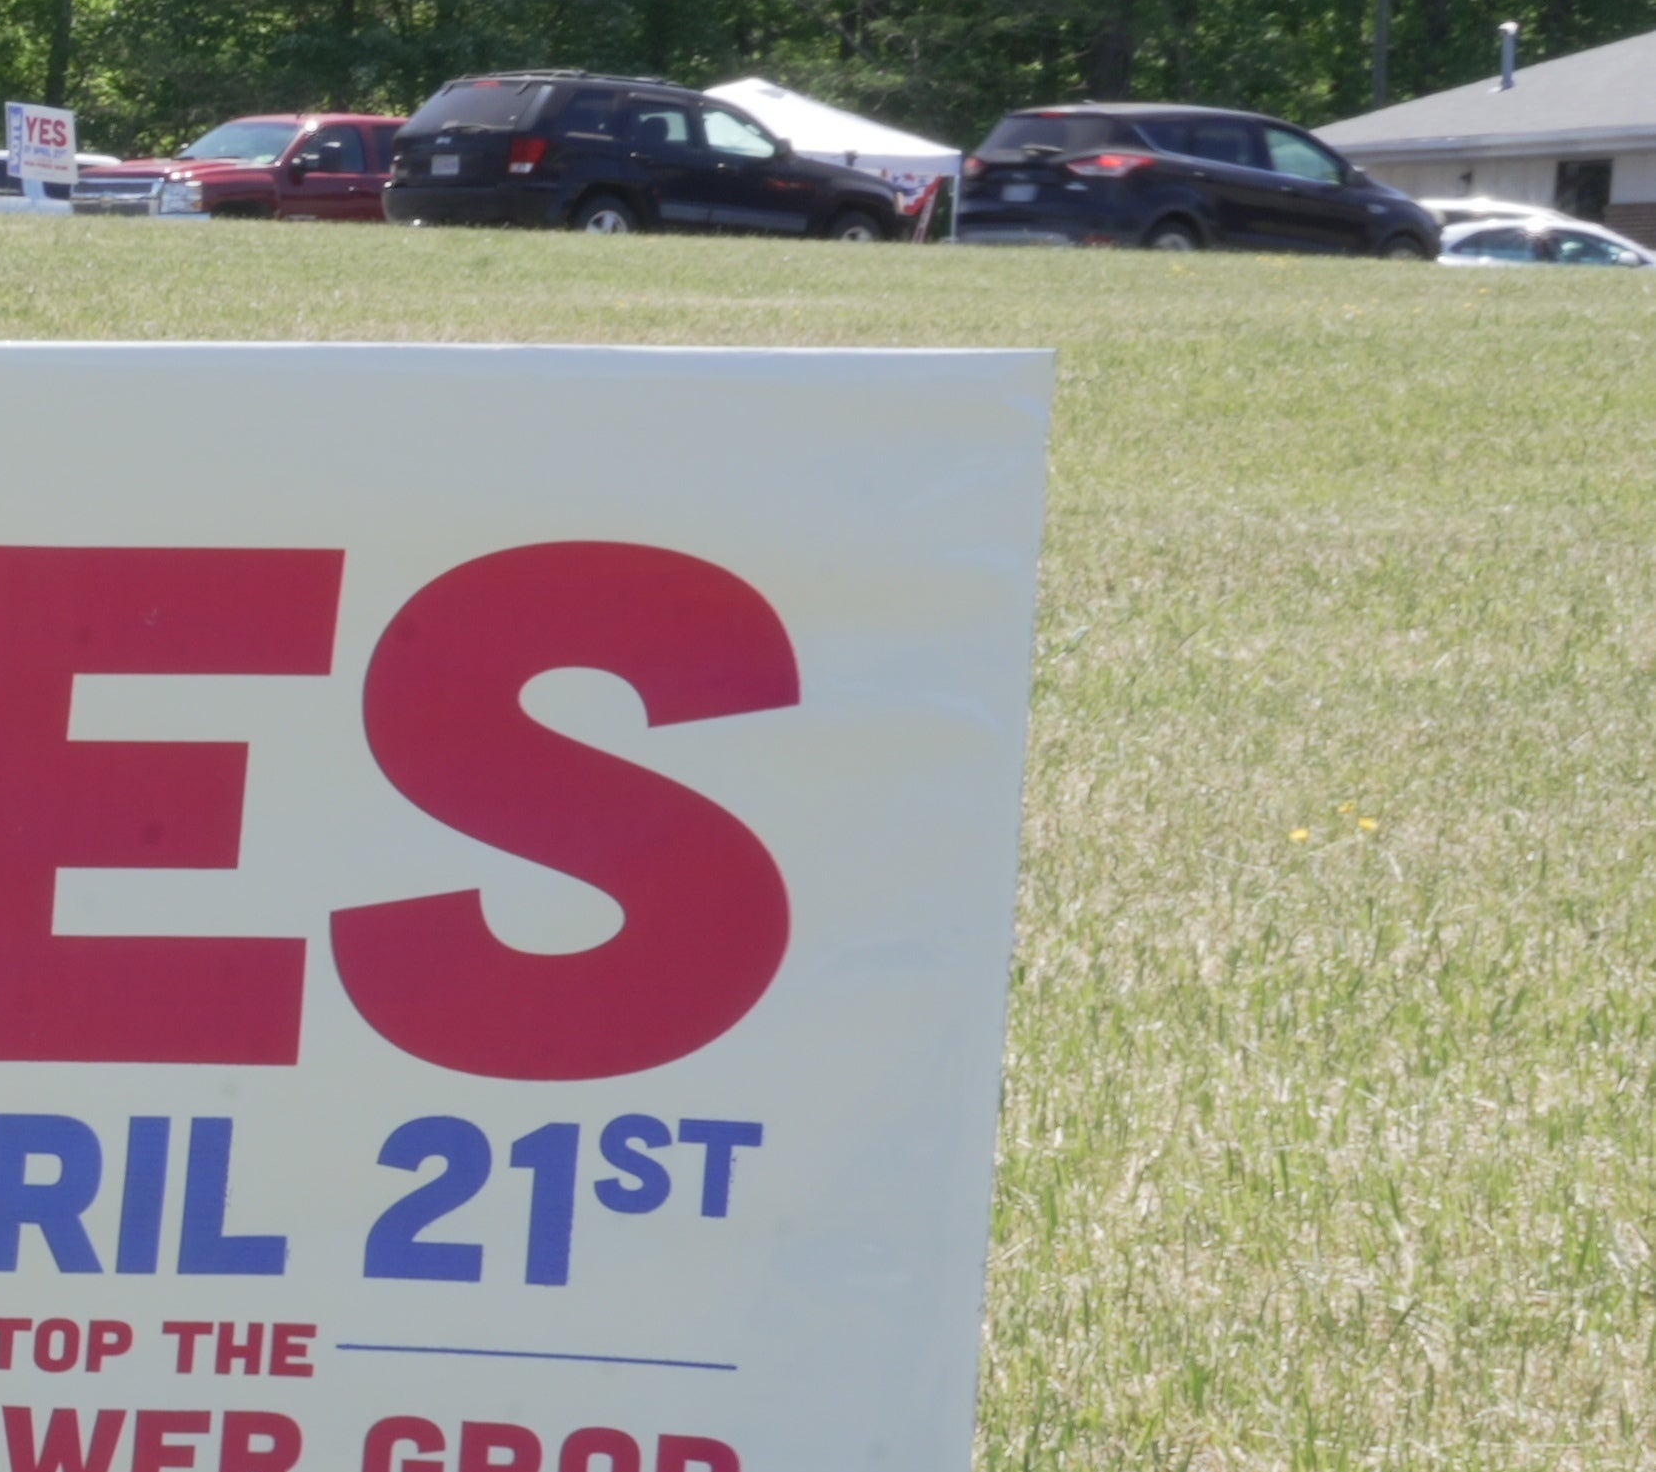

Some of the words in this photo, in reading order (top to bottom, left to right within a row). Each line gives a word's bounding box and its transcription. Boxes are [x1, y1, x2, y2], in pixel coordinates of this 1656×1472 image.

[26, 116, 67, 147] YES
[361, 1114, 764, 1287] 21ST
[162, 1319, 317, 1379] THE
